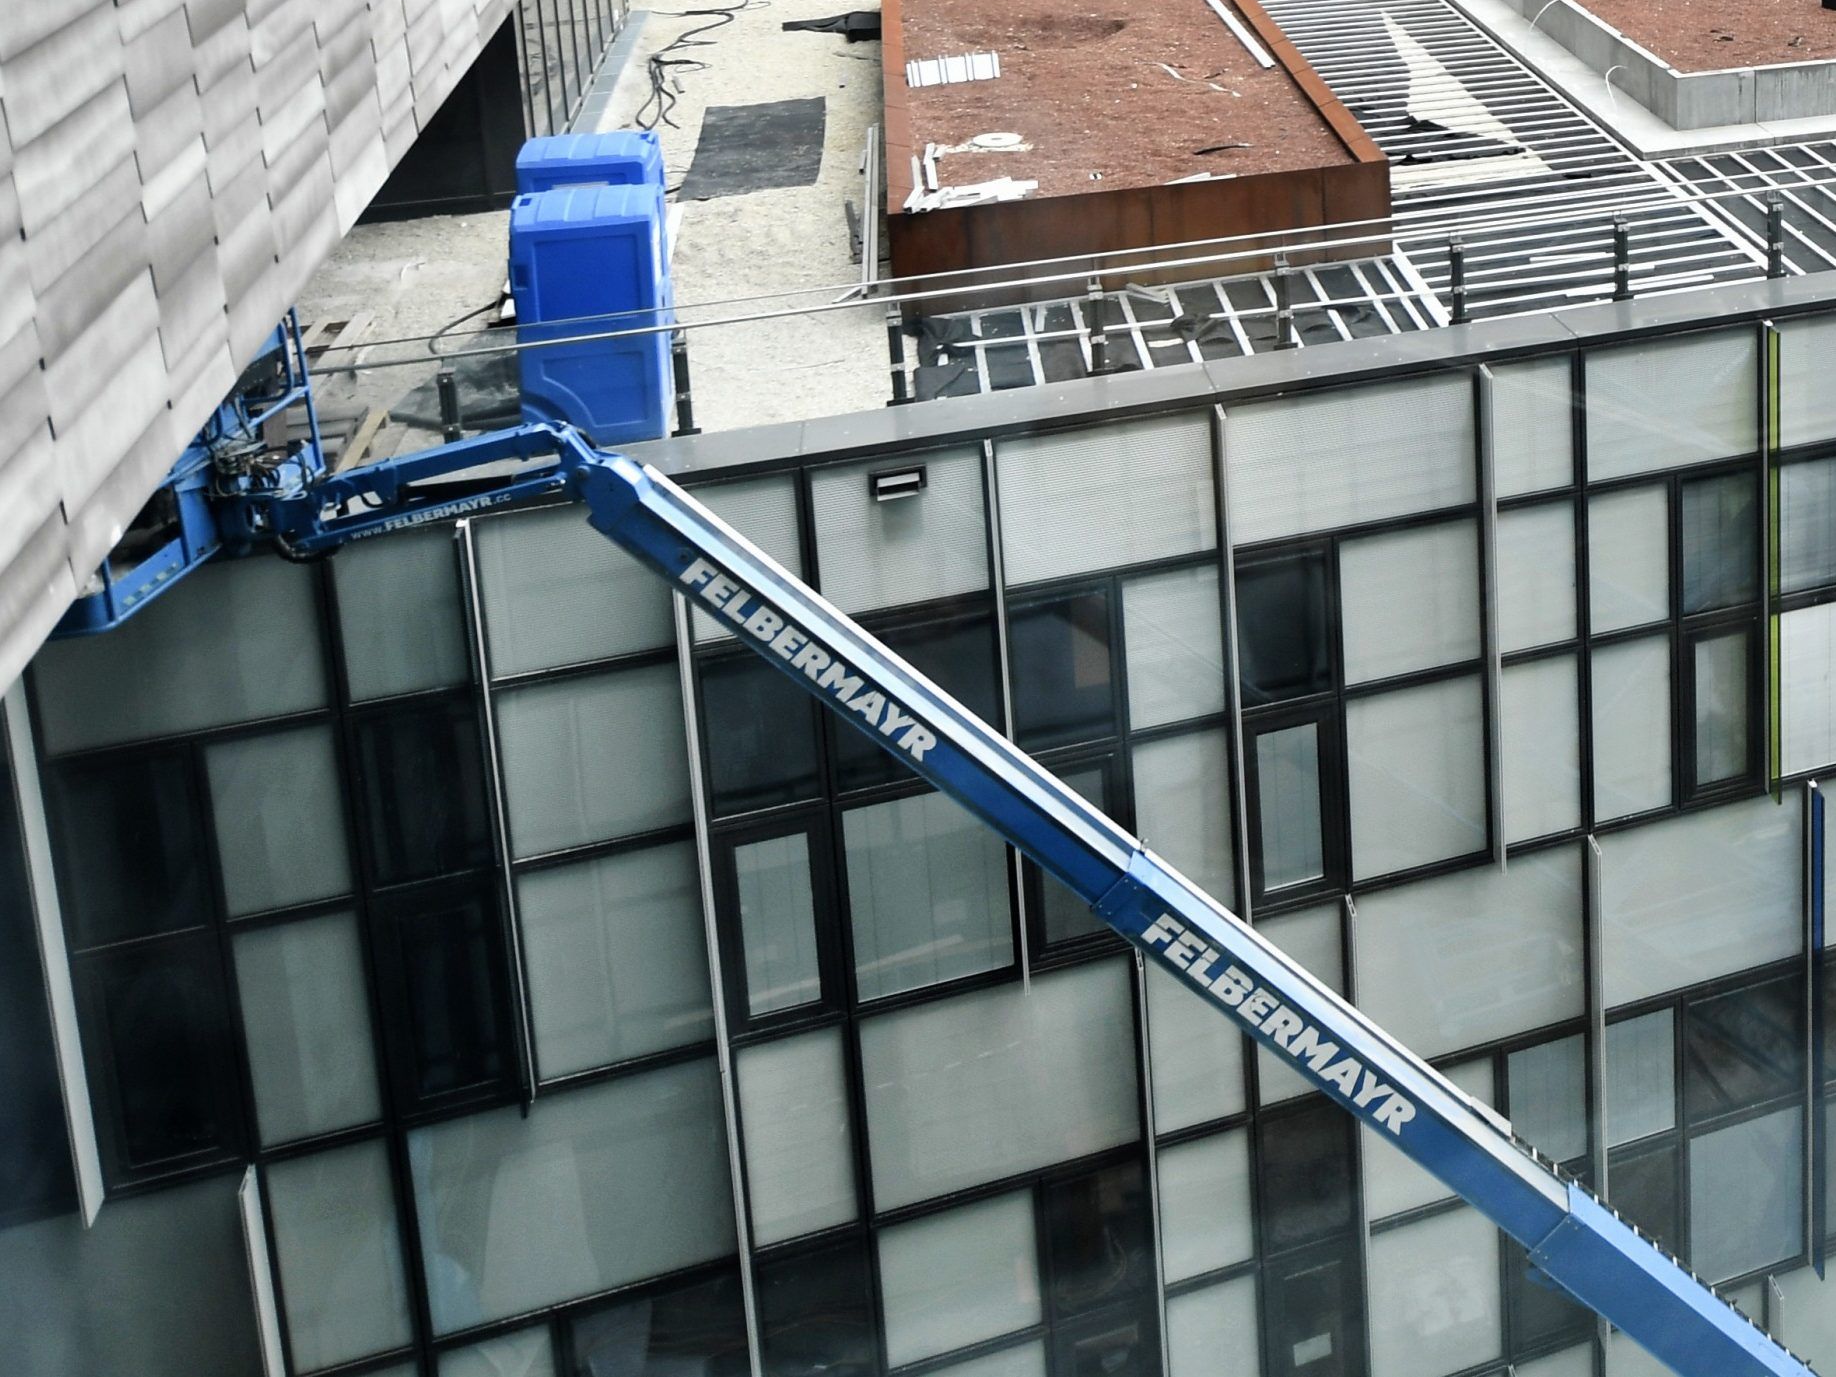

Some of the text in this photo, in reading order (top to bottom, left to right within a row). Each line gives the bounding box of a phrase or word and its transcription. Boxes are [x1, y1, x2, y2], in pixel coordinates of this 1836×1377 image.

[351, 493, 511, 540] www.FELBERMAYR.cc
[679, 557, 937, 762] FELBERMAYR
[1141, 913, 1416, 1135] FELBERMAYR
